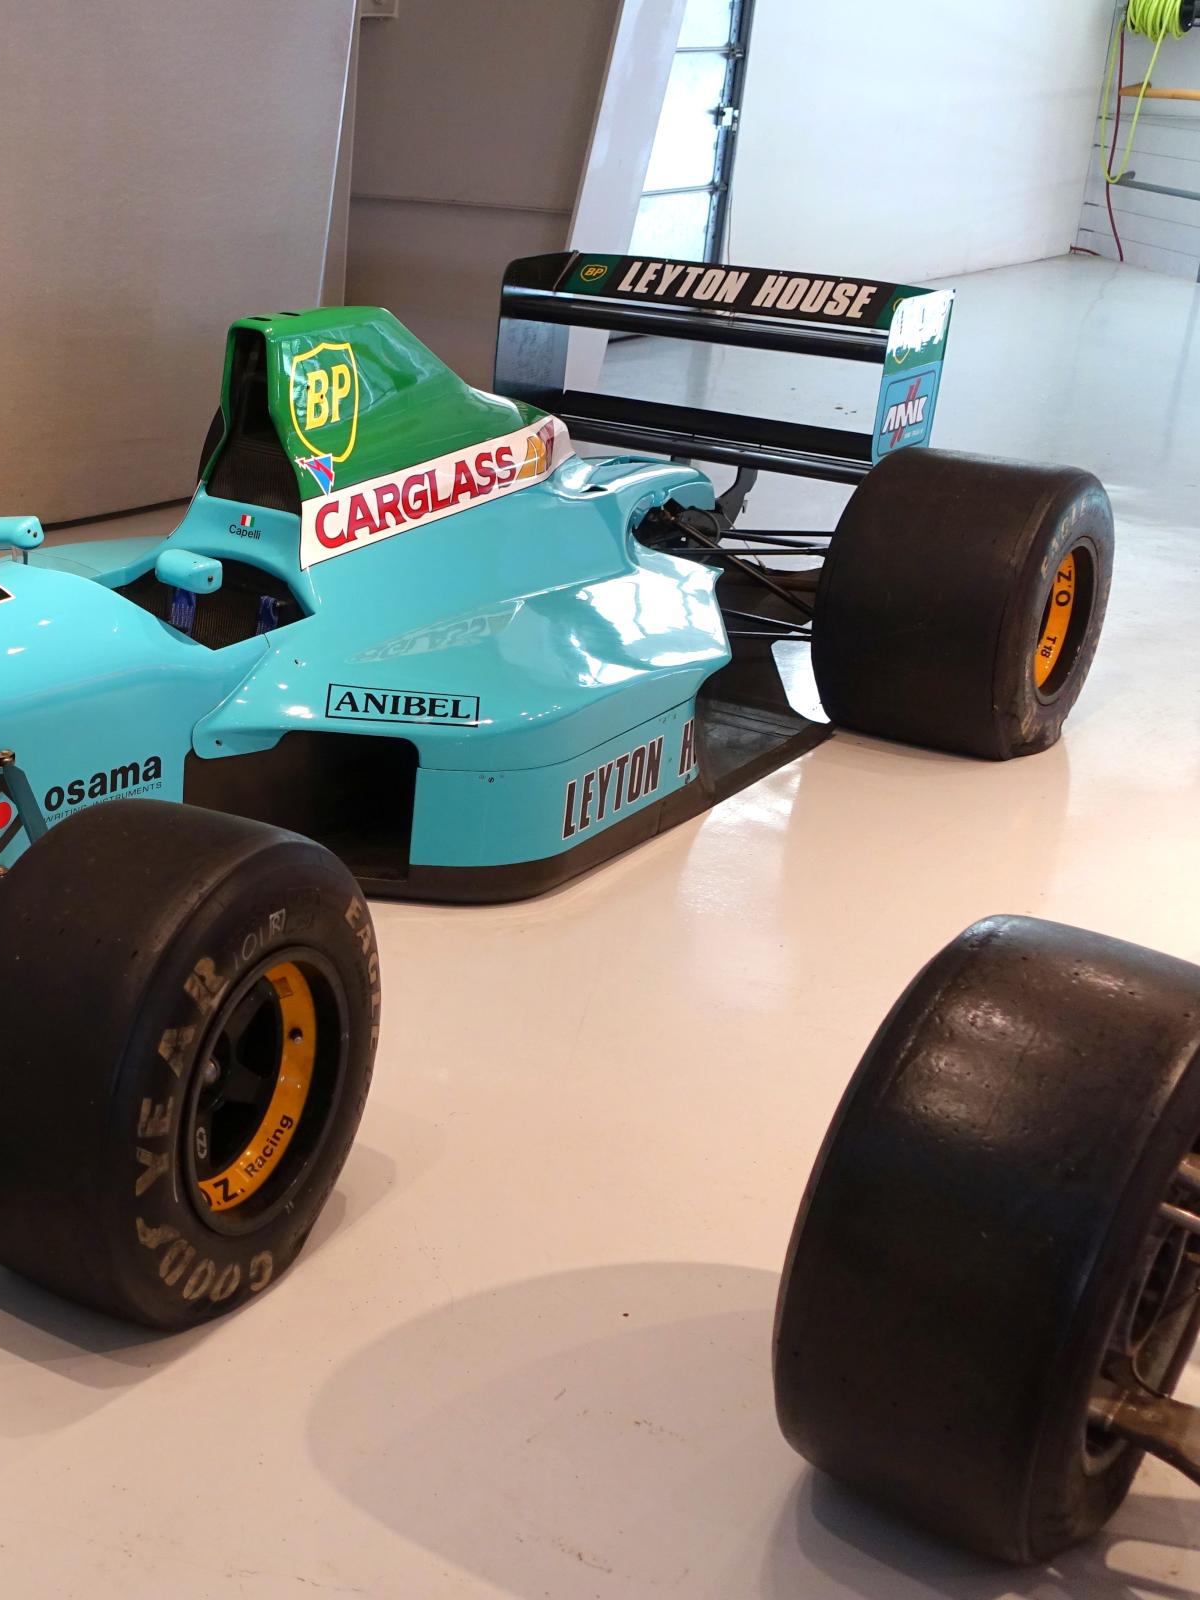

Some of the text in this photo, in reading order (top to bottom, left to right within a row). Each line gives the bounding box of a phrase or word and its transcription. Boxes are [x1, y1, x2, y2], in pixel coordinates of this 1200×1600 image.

[584, 266, 605, 277] BP
[616, 261, 878, 318] LEYTON HOUSE
[304, 363, 351, 431] BP
[315, 446, 518, 549] CARGLASS
[229, 524, 262, 540] Capelli
[334, 691, 471, 719] ANIBEL
[44, 755, 162, 811] osama
[562, 735, 664, 840] LEYTON
[243, 1114, 294, 1178] Racing
